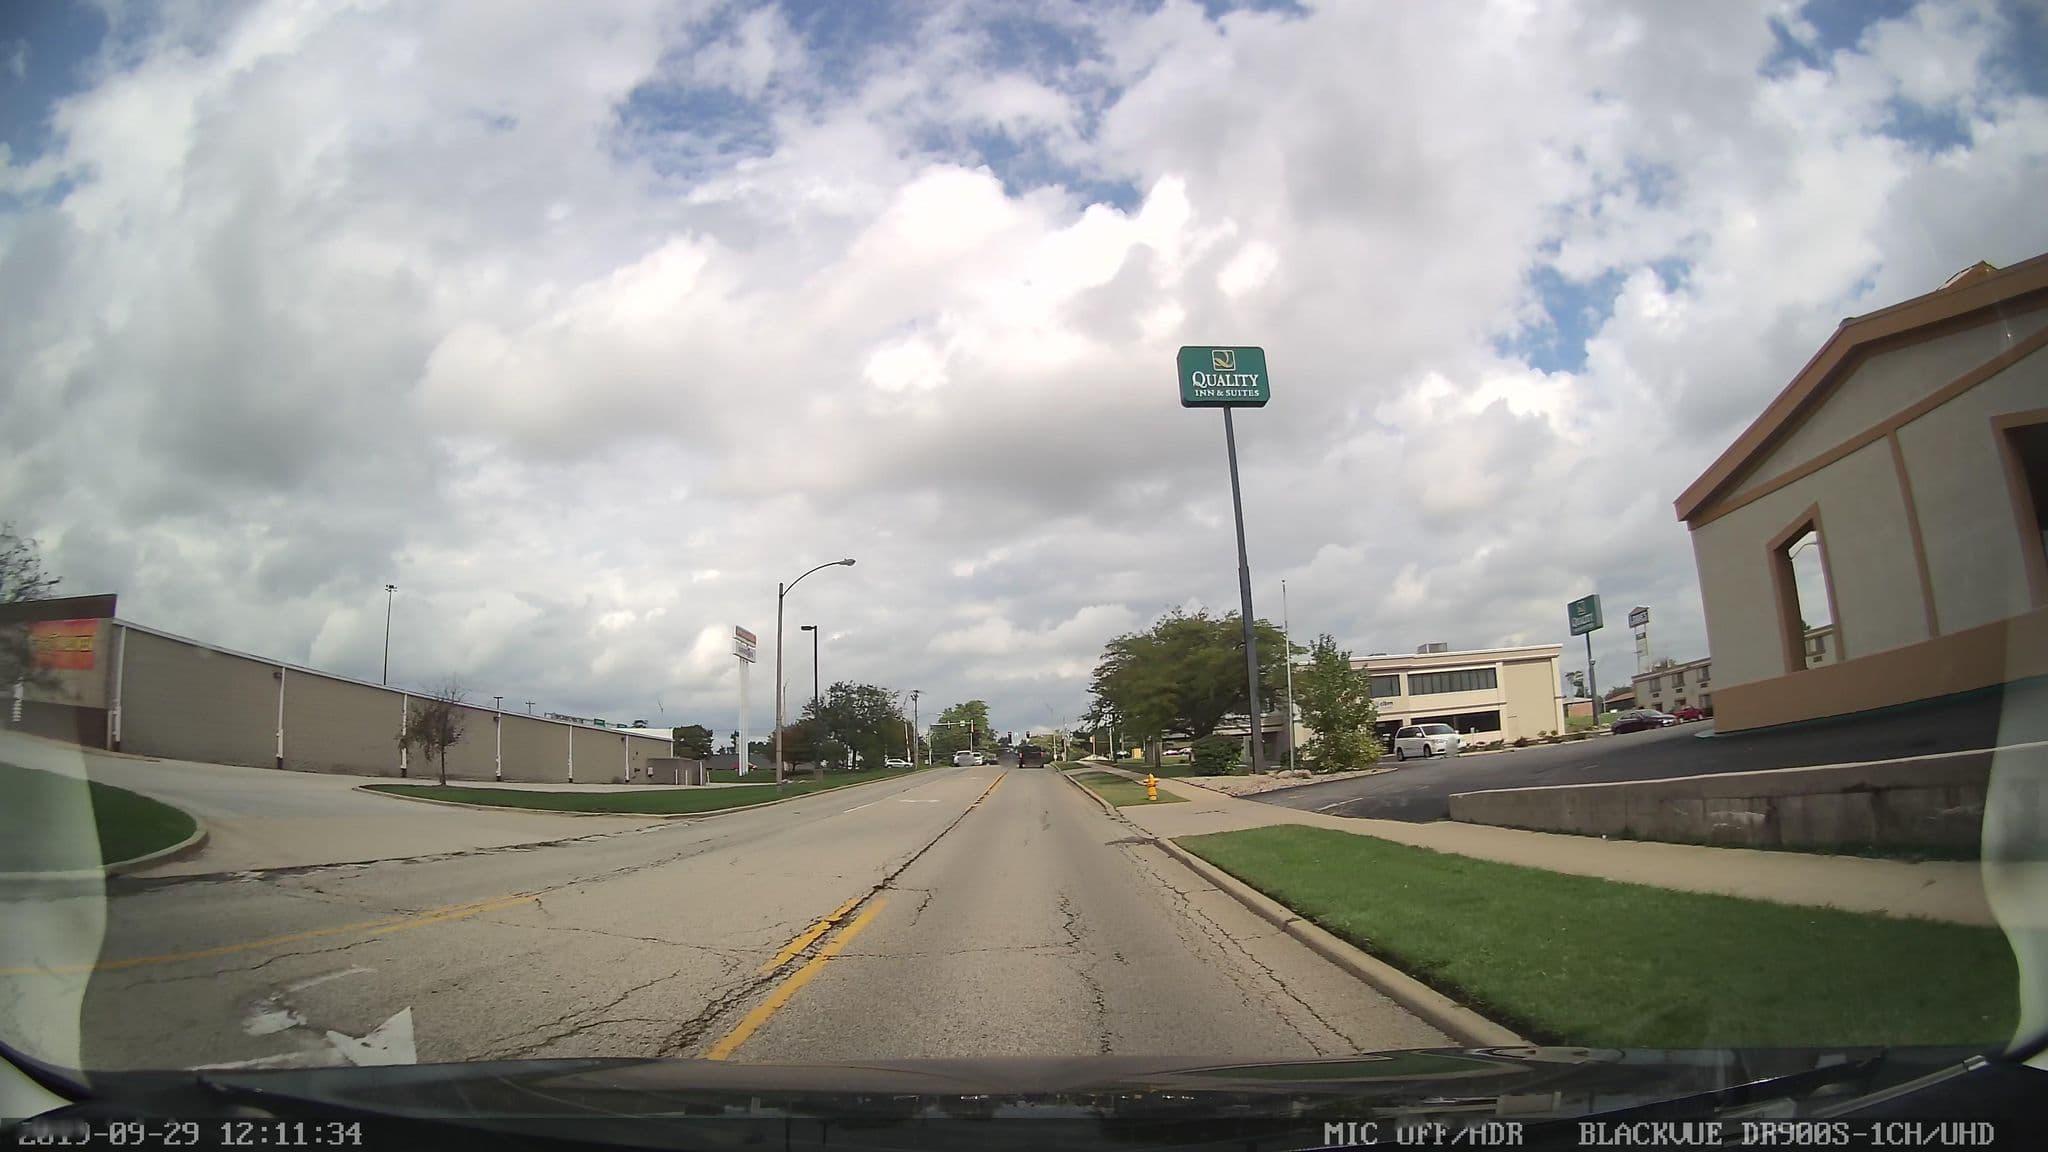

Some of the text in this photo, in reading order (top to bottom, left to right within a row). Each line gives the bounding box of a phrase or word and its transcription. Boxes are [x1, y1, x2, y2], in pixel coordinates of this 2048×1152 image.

[1192, 371, 1259, 388] QUALITY
[1195, 389, 1260, 397] INN & SUITES
